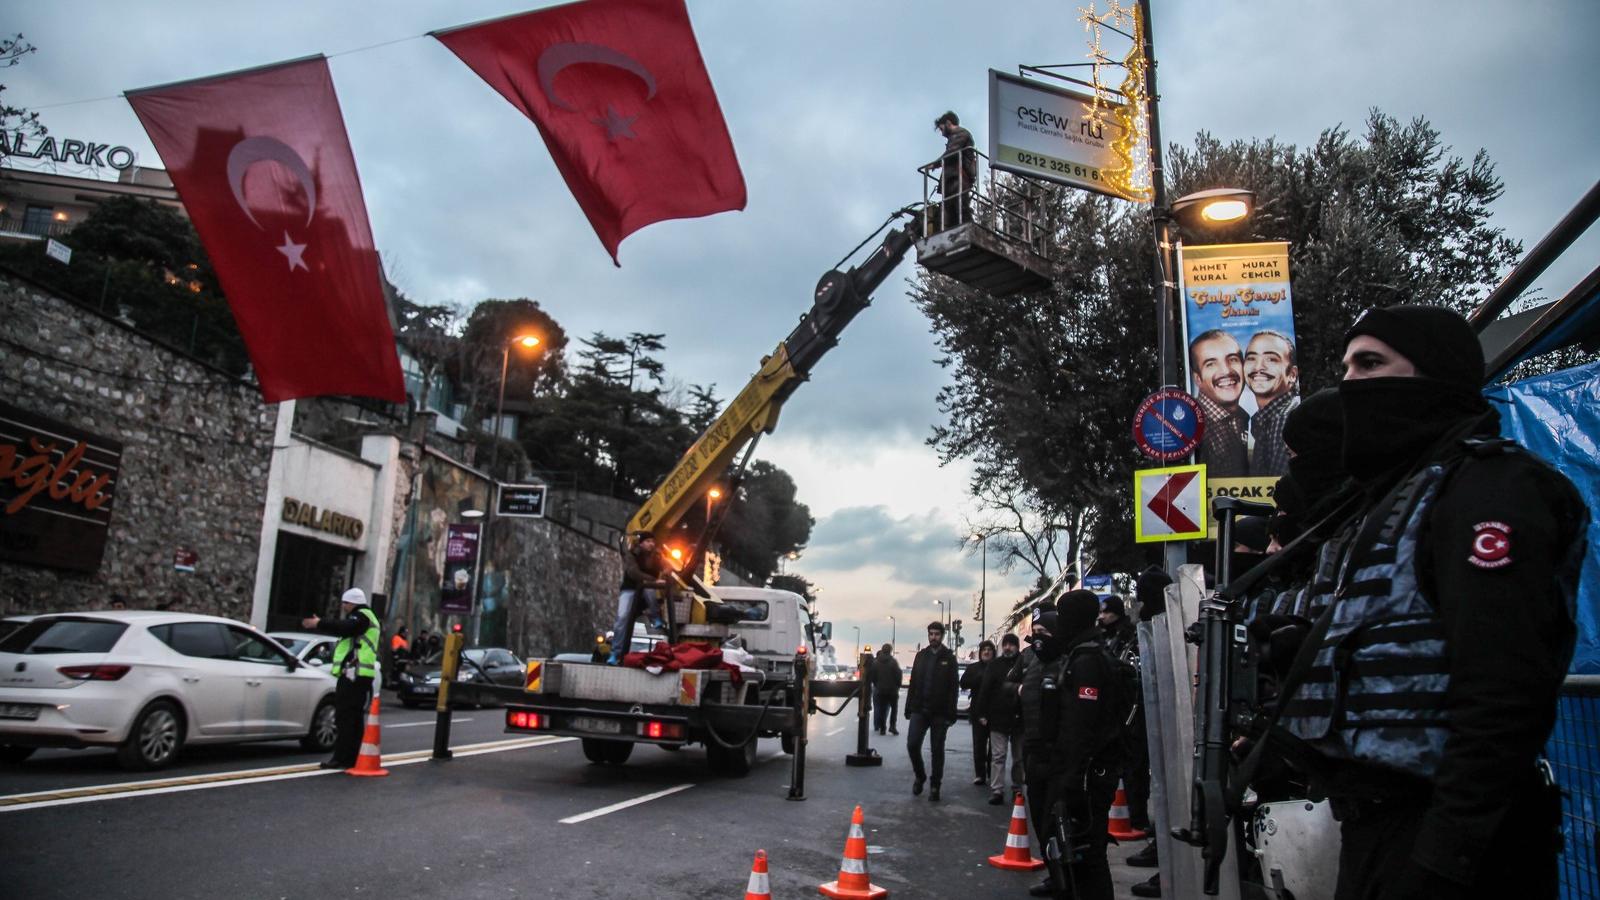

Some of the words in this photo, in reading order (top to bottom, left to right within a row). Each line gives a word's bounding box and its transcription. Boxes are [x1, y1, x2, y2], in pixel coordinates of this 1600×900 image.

[1018, 121, 1038, 132] Plastik
[1040, 126, 1062, 137] Cerrahi
[1018, 152, 1046, 167] 0212
[1050, 160, 1071, 174] 325
[1074, 166, 1087, 177] 61
[1192, 263, 1227, 272] AHMET
[1242, 260, 1278, 269] MURAT
[1193, 273, 1227, 281] KURAL
[1142, 443, 1160, 457] PARK
[1217, 486, 1262, 497] OCAK
